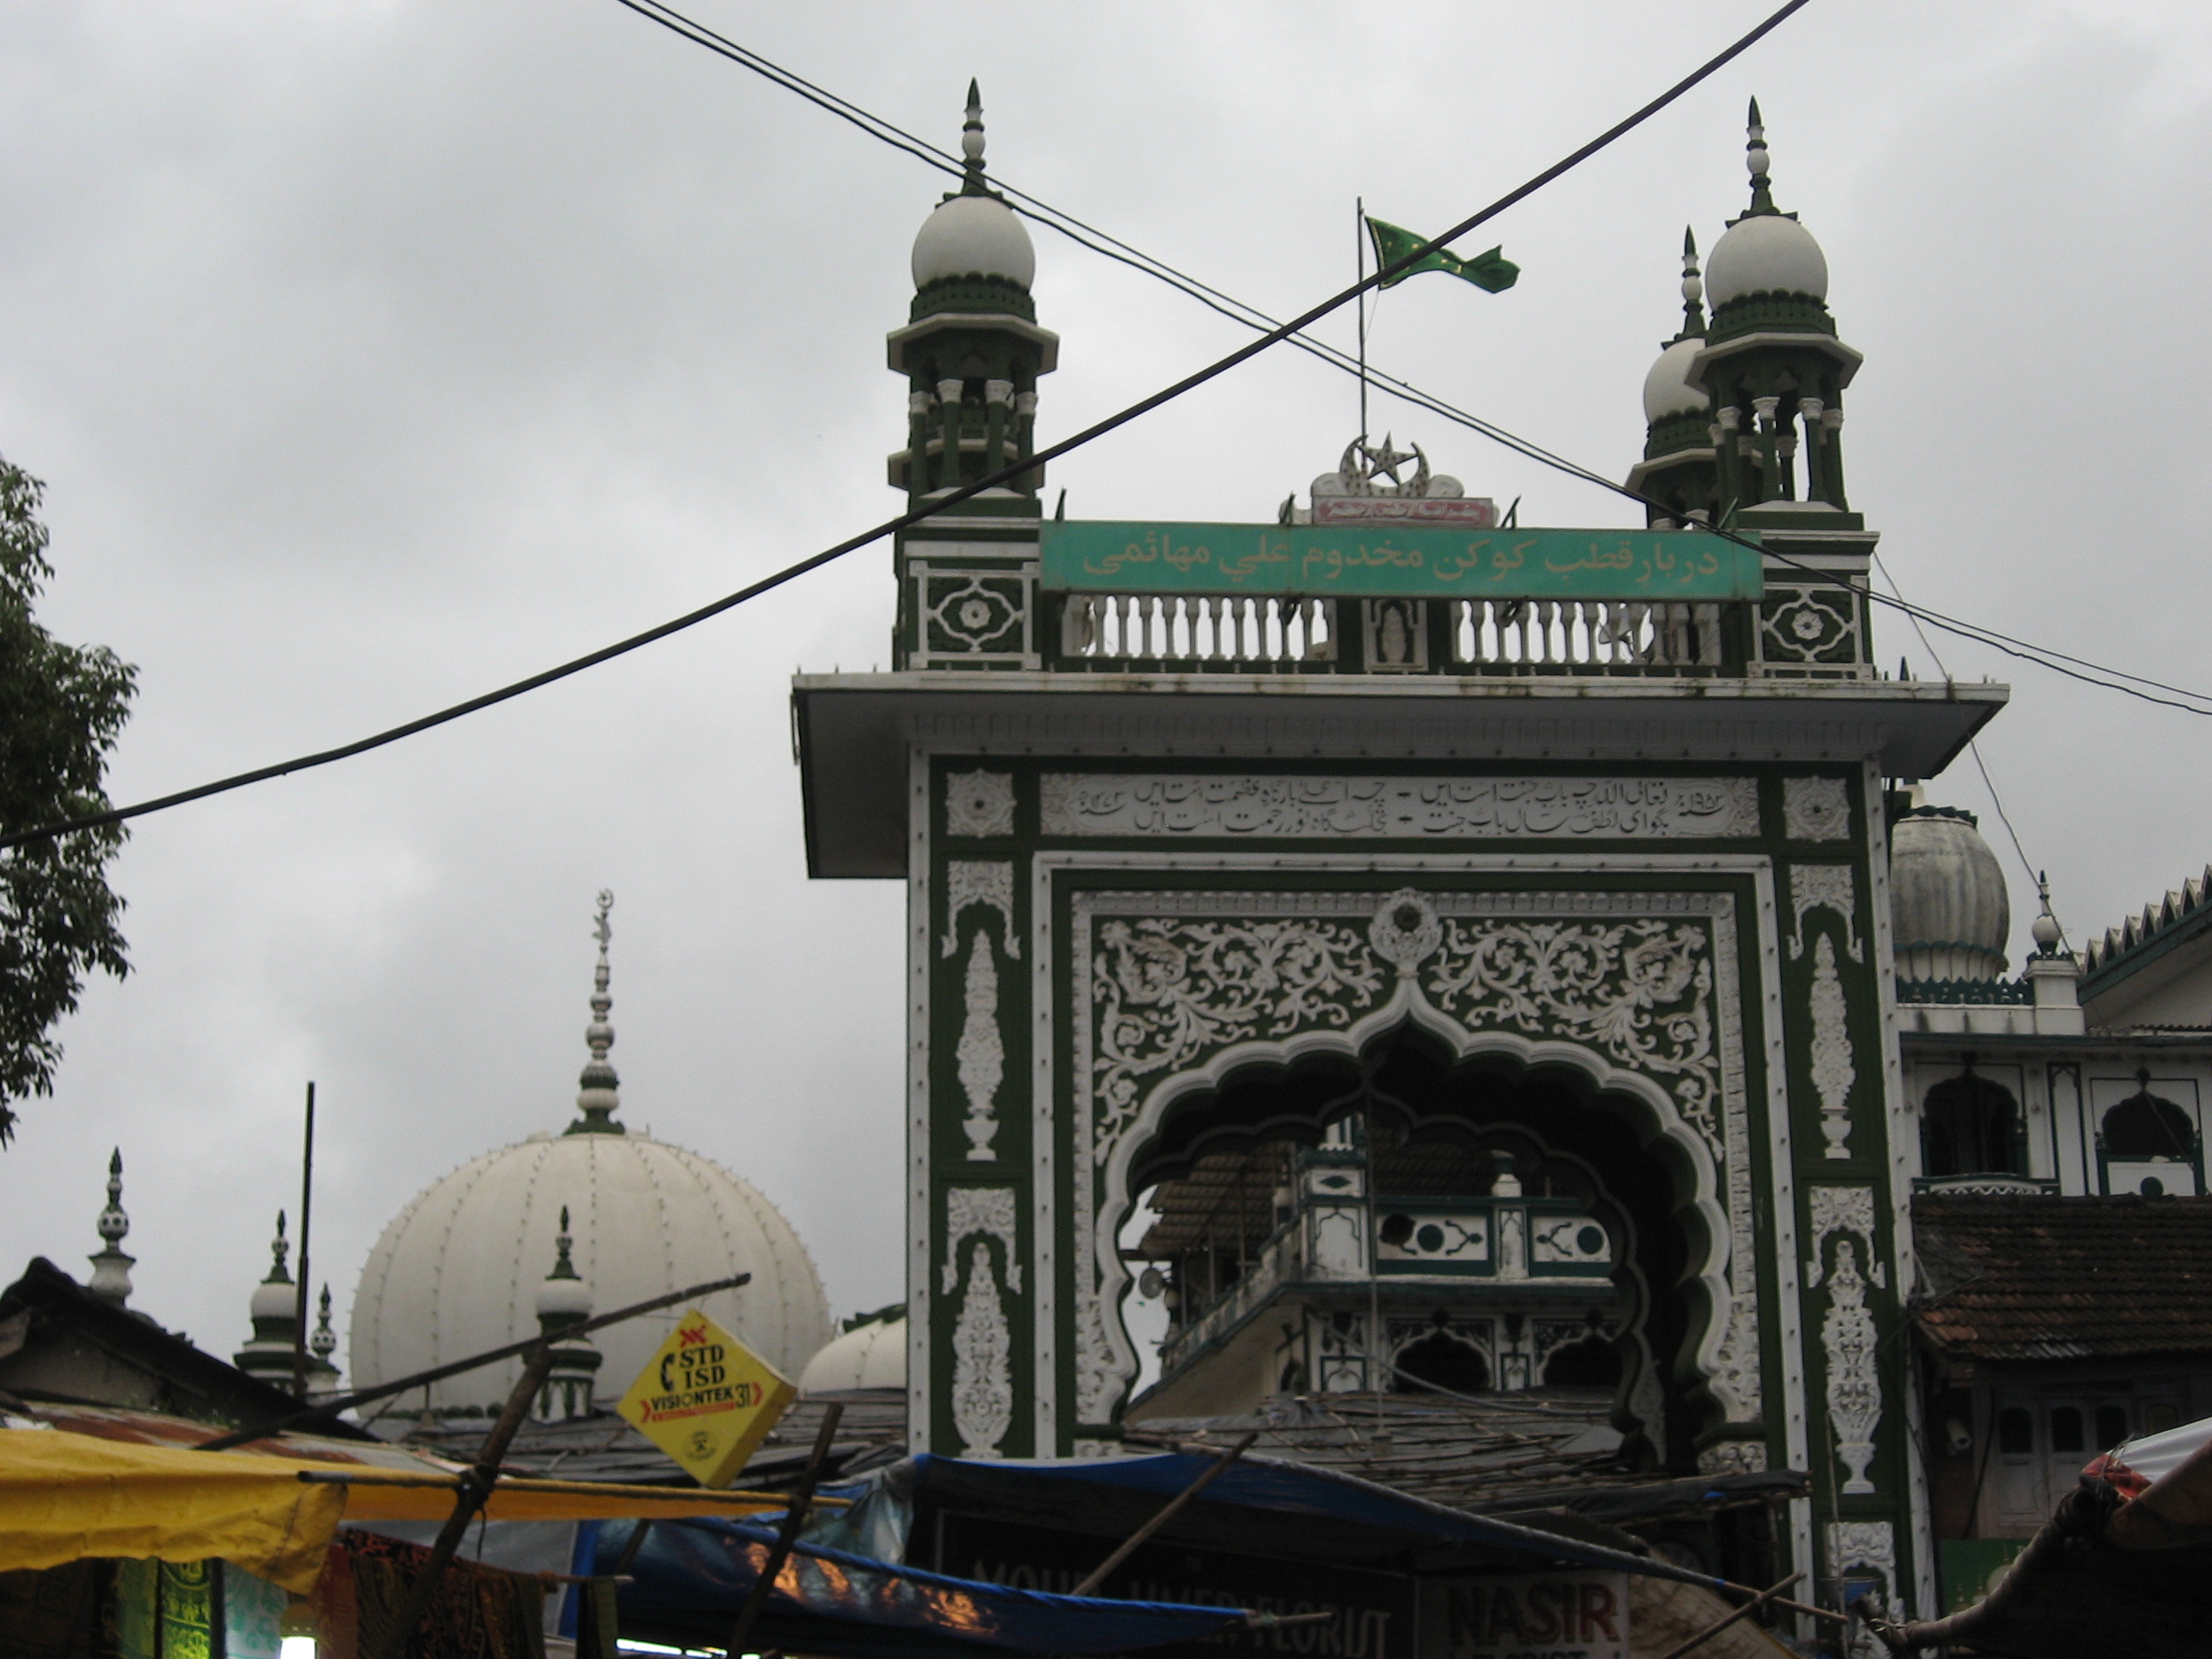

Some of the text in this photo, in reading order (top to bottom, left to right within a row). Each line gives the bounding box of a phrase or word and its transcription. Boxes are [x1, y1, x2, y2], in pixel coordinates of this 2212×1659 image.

[1302, 538, 1424, 580] مخدوم
[679, 1344, 724, 1368] STD
[684, 1366, 725, 1389] ISD
[651, 1386, 734, 1412] VISIONTEK
[1446, 1581, 1621, 1648] NASIR
